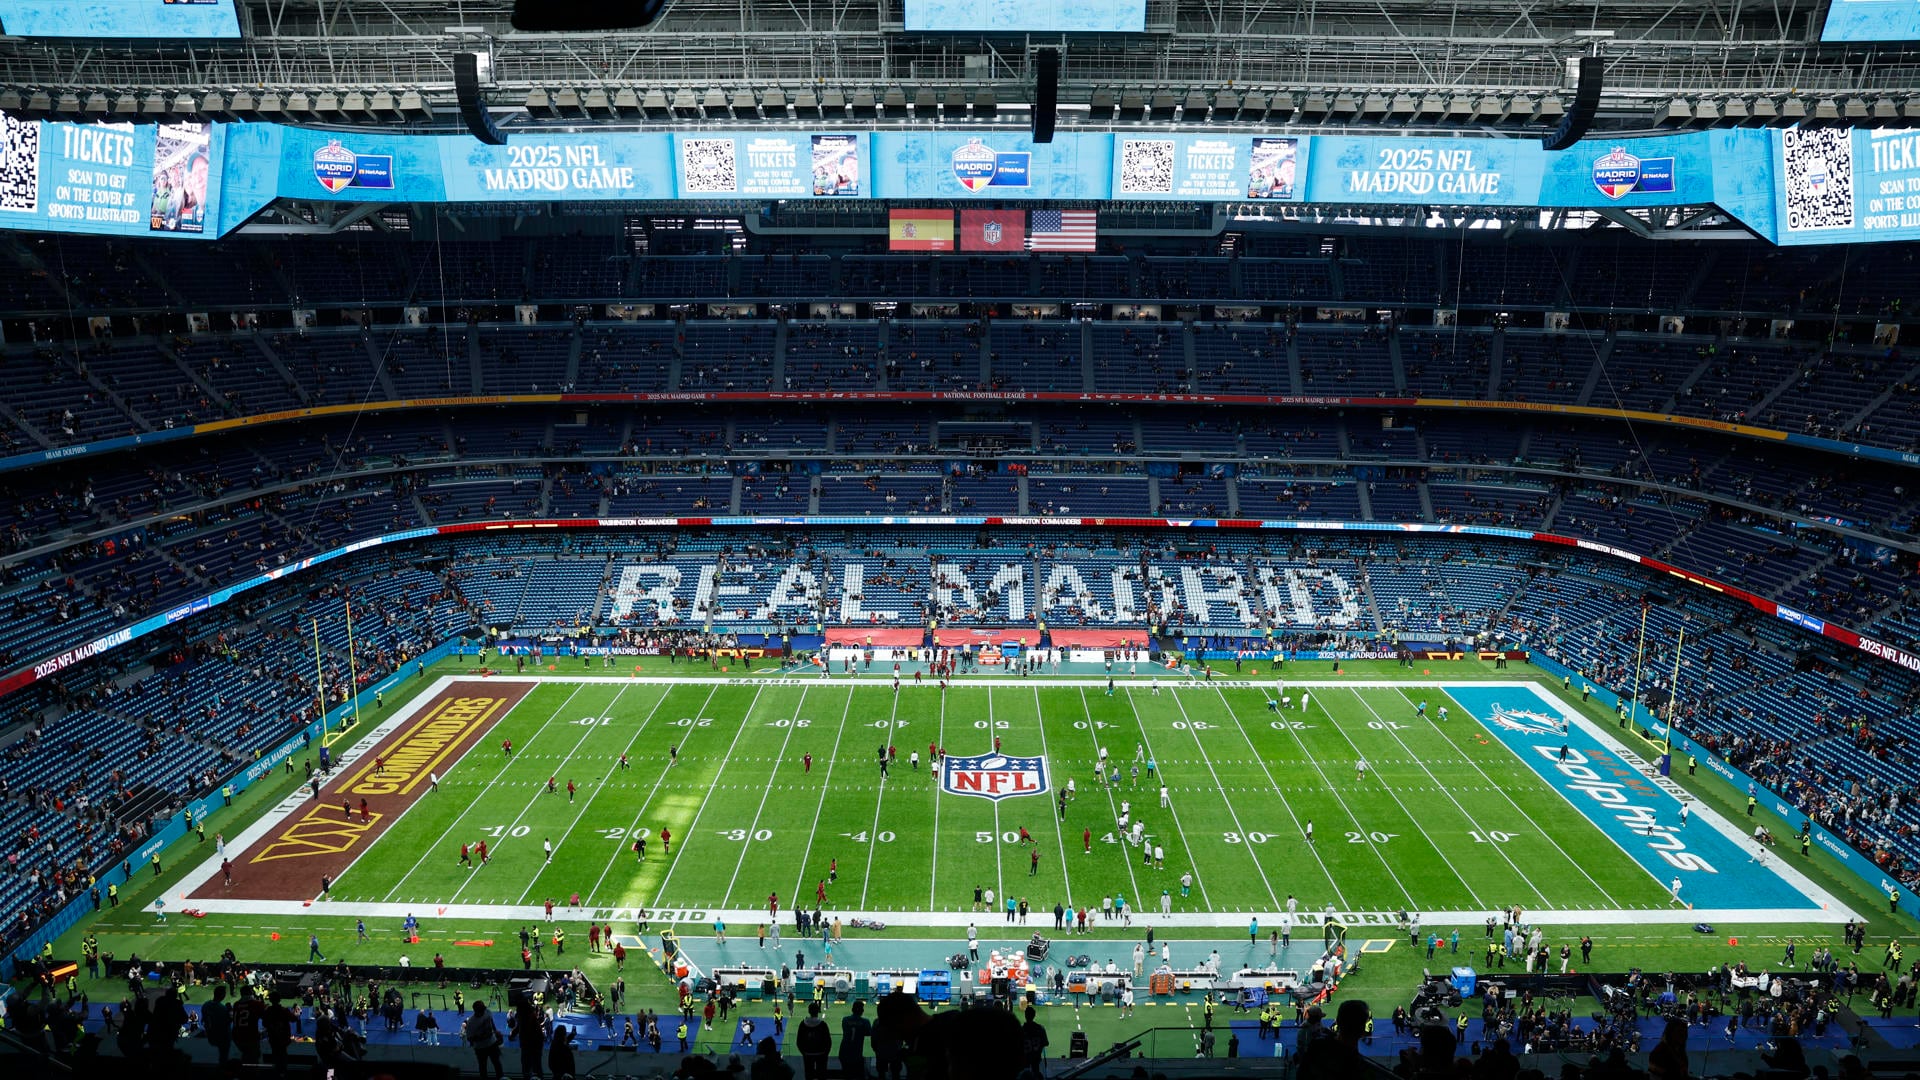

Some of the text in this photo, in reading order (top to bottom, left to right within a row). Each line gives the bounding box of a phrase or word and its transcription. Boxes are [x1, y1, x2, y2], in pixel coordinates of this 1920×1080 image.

[63, 126, 134, 167] TICKETS
[507, 145, 606, 168] 2025 NFL
[748, 152, 796, 168] TICKETS
[1378, 149, 1476, 171] 2025 NFL
[1871, 135, 1920, 173] TICK
[316, 163, 352, 172] MADRID
[956, 163, 992, 171] MADRID
[1187, 154, 1234, 169] TICKETS
[68, 169, 127, 189] SCAN TO GET
[484, 167, 635, 191] MADRID GAME
[1596, 170, 1636, 178] MADRID
[1350, 170, 1500, 194] MADRID GAME
[1880, 179, 1904, 195] SCAN
[56, 186, 135, 206] ON THE COVER OF
[1870, 199, 1885, 212] ON
[1885, 197, 1904, 211] THE
[48, 204, 140, 224] SPORTS ILLUSTRATED
[1864, 214, 1899, 229] SPORTS
[985, 231, 1000, 241] NFL
[1497, 401, 1528, 409] FOOTBALL
[45, 446, 87, 460] MIAMI DOLPHINS
[598, 518, 678, 526] WASHINGTON COMMANDERS
[1002, 518, 1082, 526] WASHINGTON COMMANDERS
[1610, 546, 1641, 563] COMMANDERS
[609, 564, 900, 622] REAL
[934, 564, 1361, 625] MADRID
[167, 607, 190, 621] MADRID
[1778, 606, 1800, 620] MADRID
[727, 626, 786, 634] 2025 NFL MADID
[1187, 628, 1250, 637] NFL MADRID GAME
[1397, 632, 1413, 642] IAMI
[34, 628, 132, 680] 2025 NFL MADRID GAME
[580, 647, 660, 655] 2025 NFL MADRID GAME
[1317, 651, 1335, 659] 2025
[1350, 652, 1377, 660] MADRID
[1378, 651, 1398, 659] GAME
[1859, 637, 1882, 655] 2025
[1881, 645, 1899, 664] NFL
[580, 717, 614, 726] 10
[677, 717, 714, 727] 20
[775, 718, 812, 728] 30
[873, 719, 910, 729] 40
[974, 720, 1010, 729] 50
[1073, 720, 1109, 730] 40
[1172, 720, 1209, 730] 30
[1270, 721, 1306, 730] 20
[1367, 721, 1404, 730] 10
[352, 697, 494, 795] COMMANDERS
[354, 740, 375, 751] OF
[369, 728, 391, 738] US
[247, 764, 260, 781] 2025
[260, 759, 273, 773] NFL
[271, 743, 294, 762] MADRID
[1615, 748, 1644, 766] END
[1583, 749, 1660, 797] MIAMI
[1706, 756, 1735, 780] Dolphins
[954, 771, 1037, 793] NFL
[1532, 745, 1719, 873] Dolphins
[1776, 802, 1788, 817] VISA
[487, 825, 531, 838] 10
[605, 828, 651, 840] 20
[727, 829, 773, 841] 30
[851, 831, 897, 843] 40
[975, 831, 1019, 844] 50
[1222, 832, 1268, 844] 30
[1344, 831, 1391, 843] 20
[1467, 830, 1510, 843] 10
[1823, 836, 1850, 860] Santander
[1881, 879, 1896, 894] Fed
[593, 909, 706, 921] MADRID
